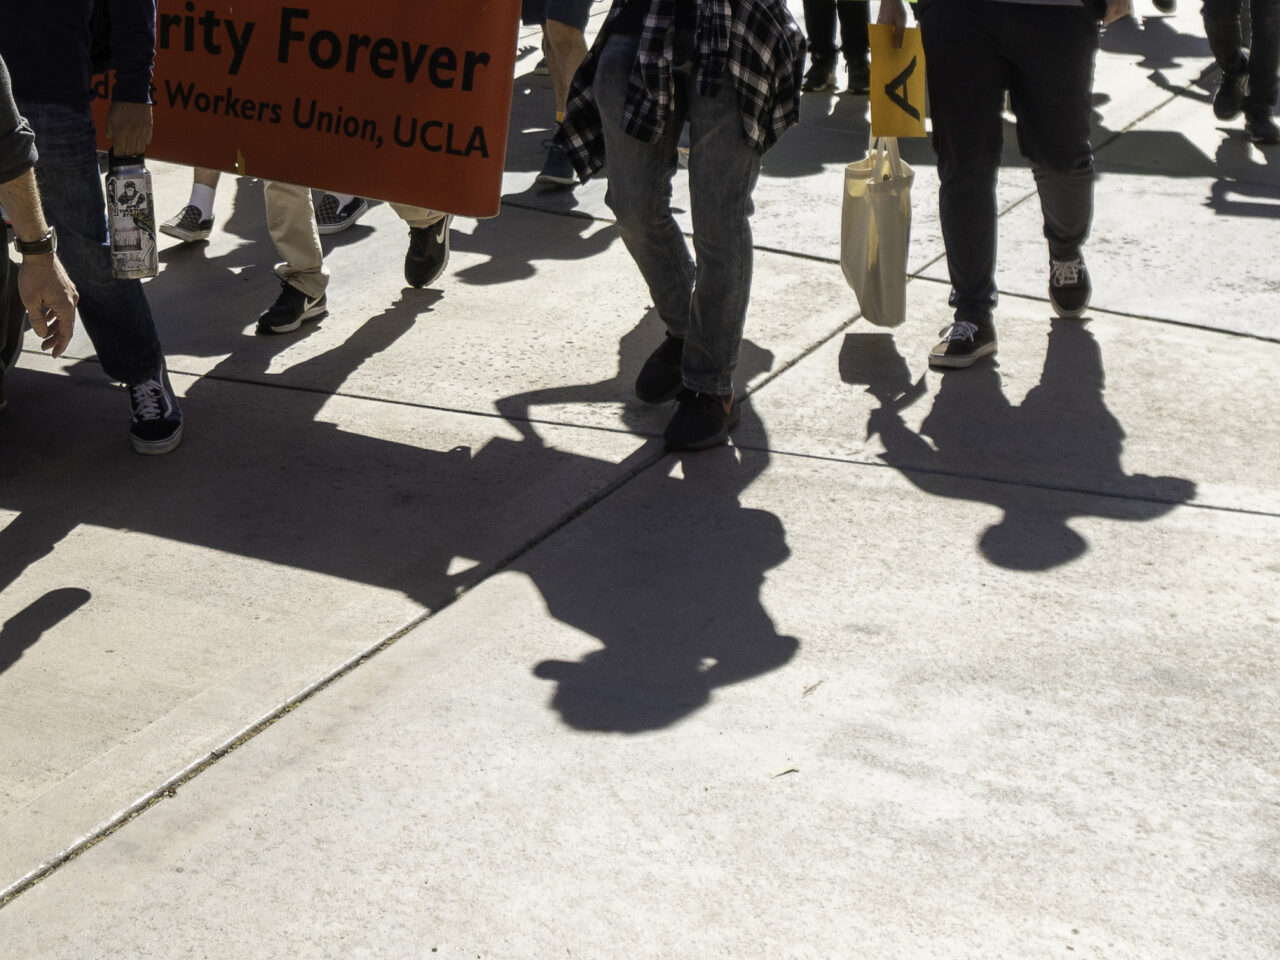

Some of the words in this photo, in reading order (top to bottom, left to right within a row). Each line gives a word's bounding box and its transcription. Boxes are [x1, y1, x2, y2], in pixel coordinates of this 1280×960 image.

[158, 1, 256, 75] rity
[277, 6, 492, 92] Forever
[164, 78, 283, 124] Workers
[292, 97, 384, 149] Union,
[392, 114, 490, 159] UCLA
